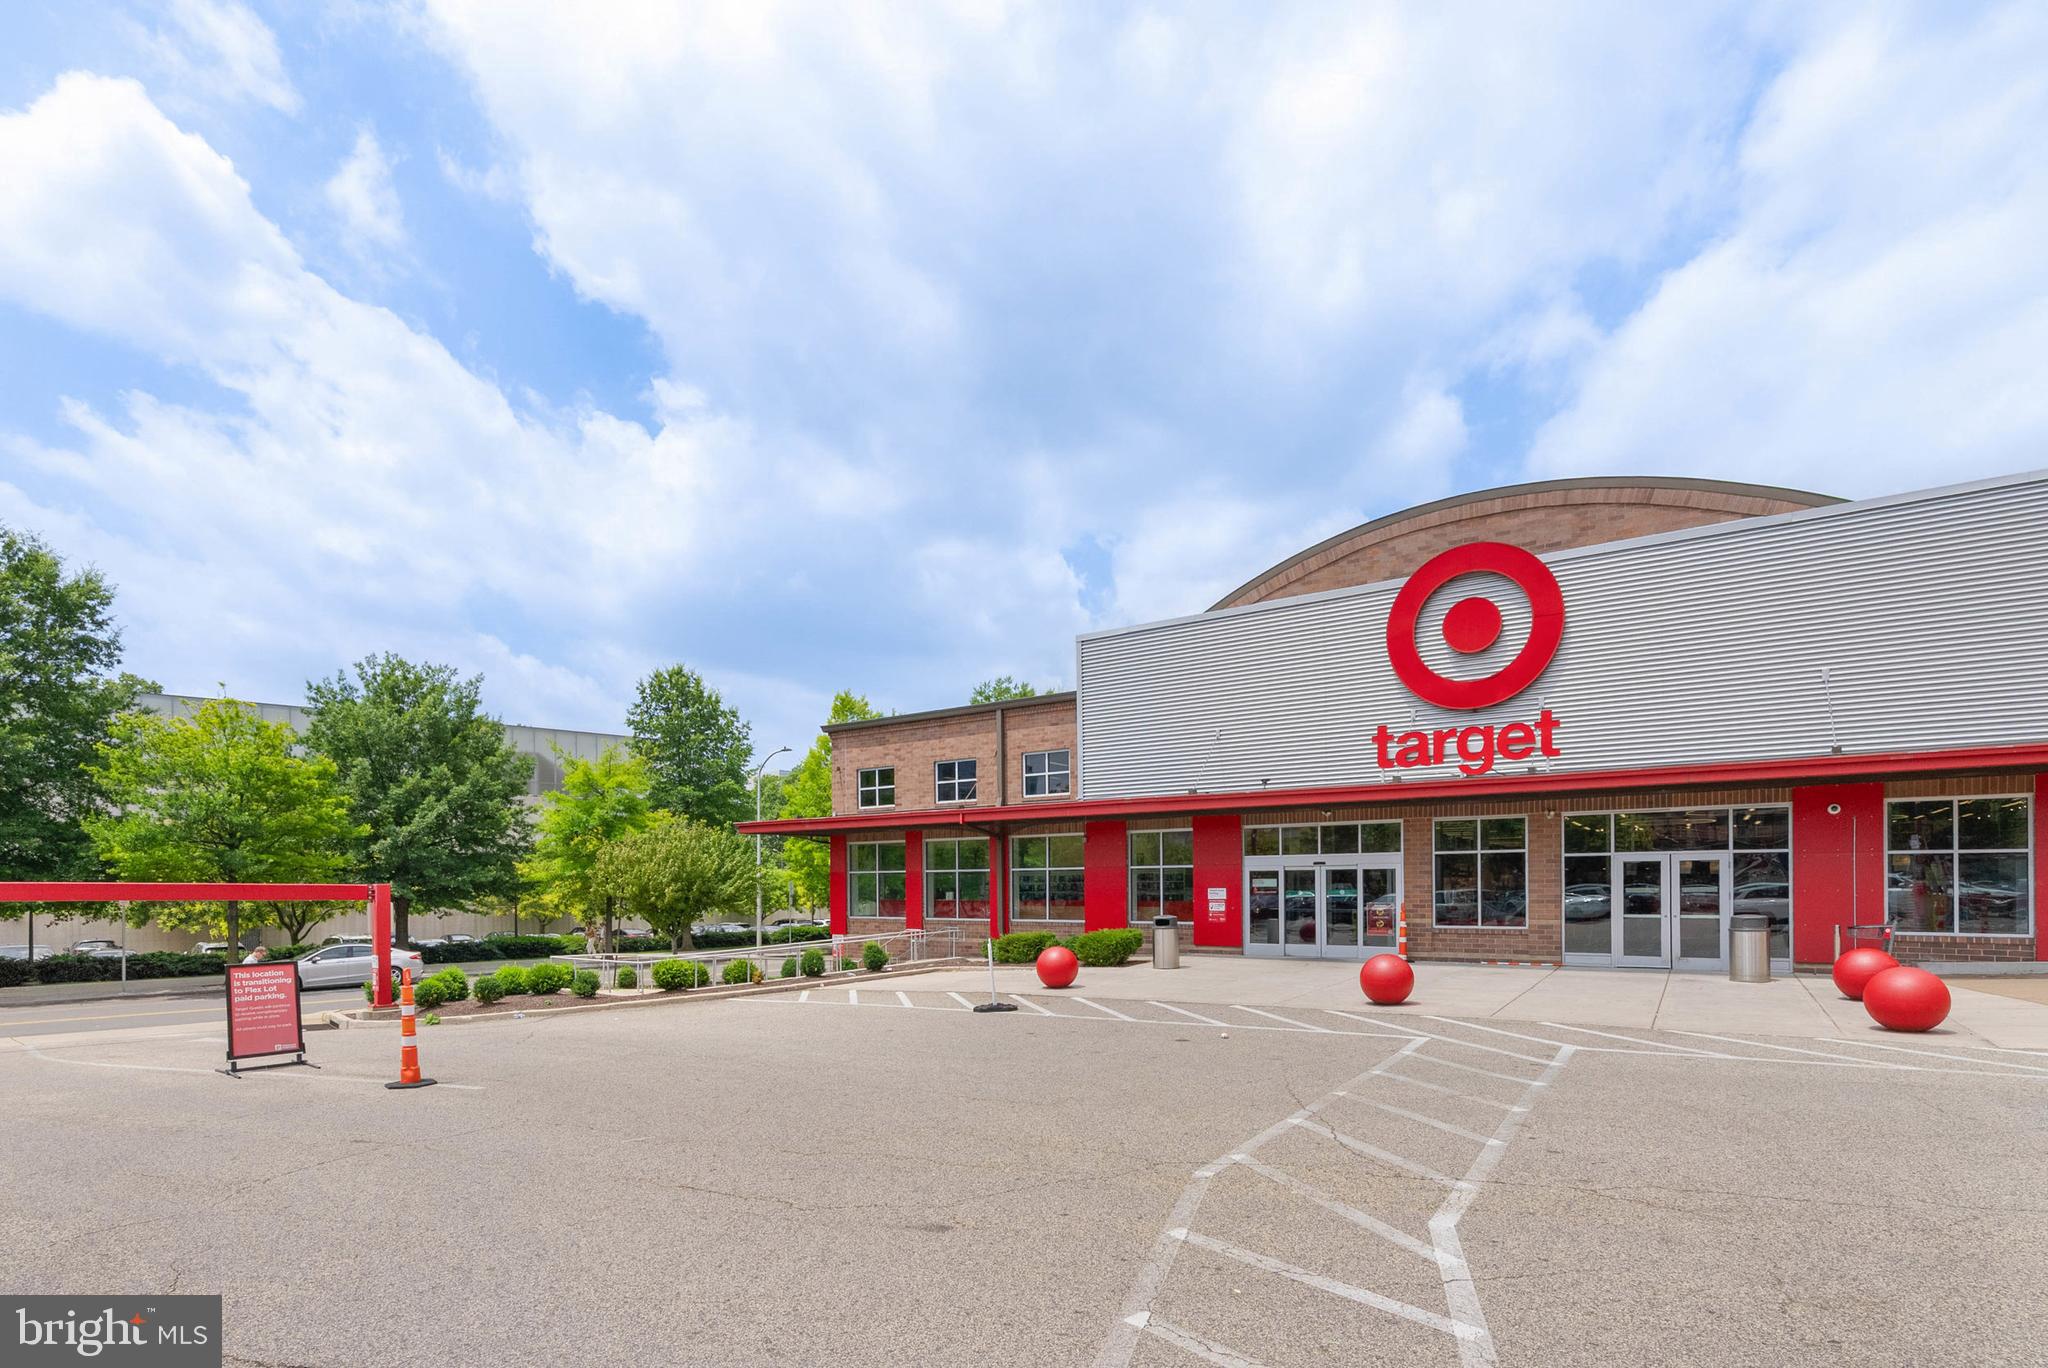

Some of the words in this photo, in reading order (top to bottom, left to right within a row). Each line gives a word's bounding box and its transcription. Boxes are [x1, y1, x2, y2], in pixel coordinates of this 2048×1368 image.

[1372, 710, 1560, 776] target
[252, 970, 284, 978] location
[242, 977, 292, 986] transitioning
[263, 985, 278, 993] Lot
[234, 994, 253, 1003] paid
[254, 992, 287, 1002] parking.
